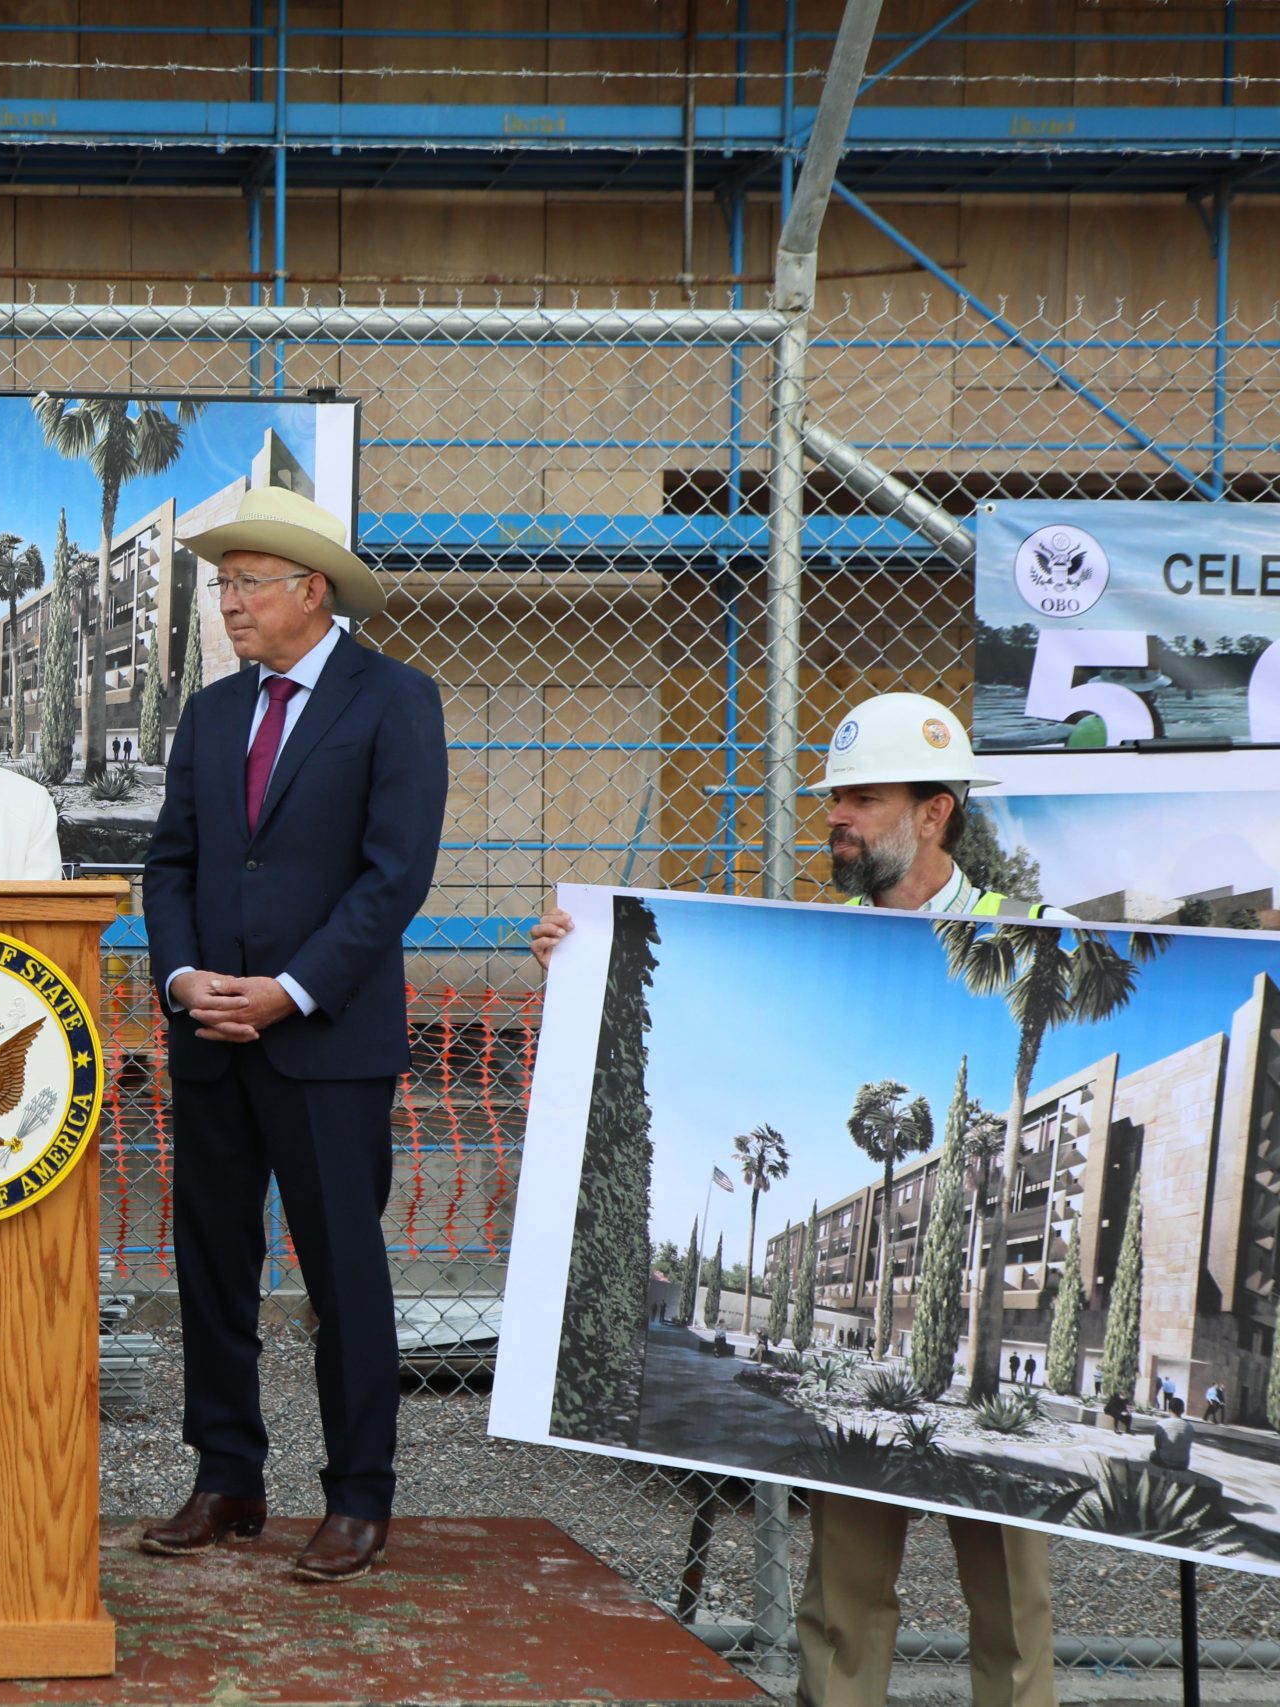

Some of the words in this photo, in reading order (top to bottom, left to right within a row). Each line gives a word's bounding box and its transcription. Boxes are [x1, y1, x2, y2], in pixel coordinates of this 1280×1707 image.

[1163, 552, 1280, 596] CELE
[1041, 598, 1080, 612] OBO
[21, 960, 84, 1032] STATE
[21, 1093, 93, 1197] AMERICA
